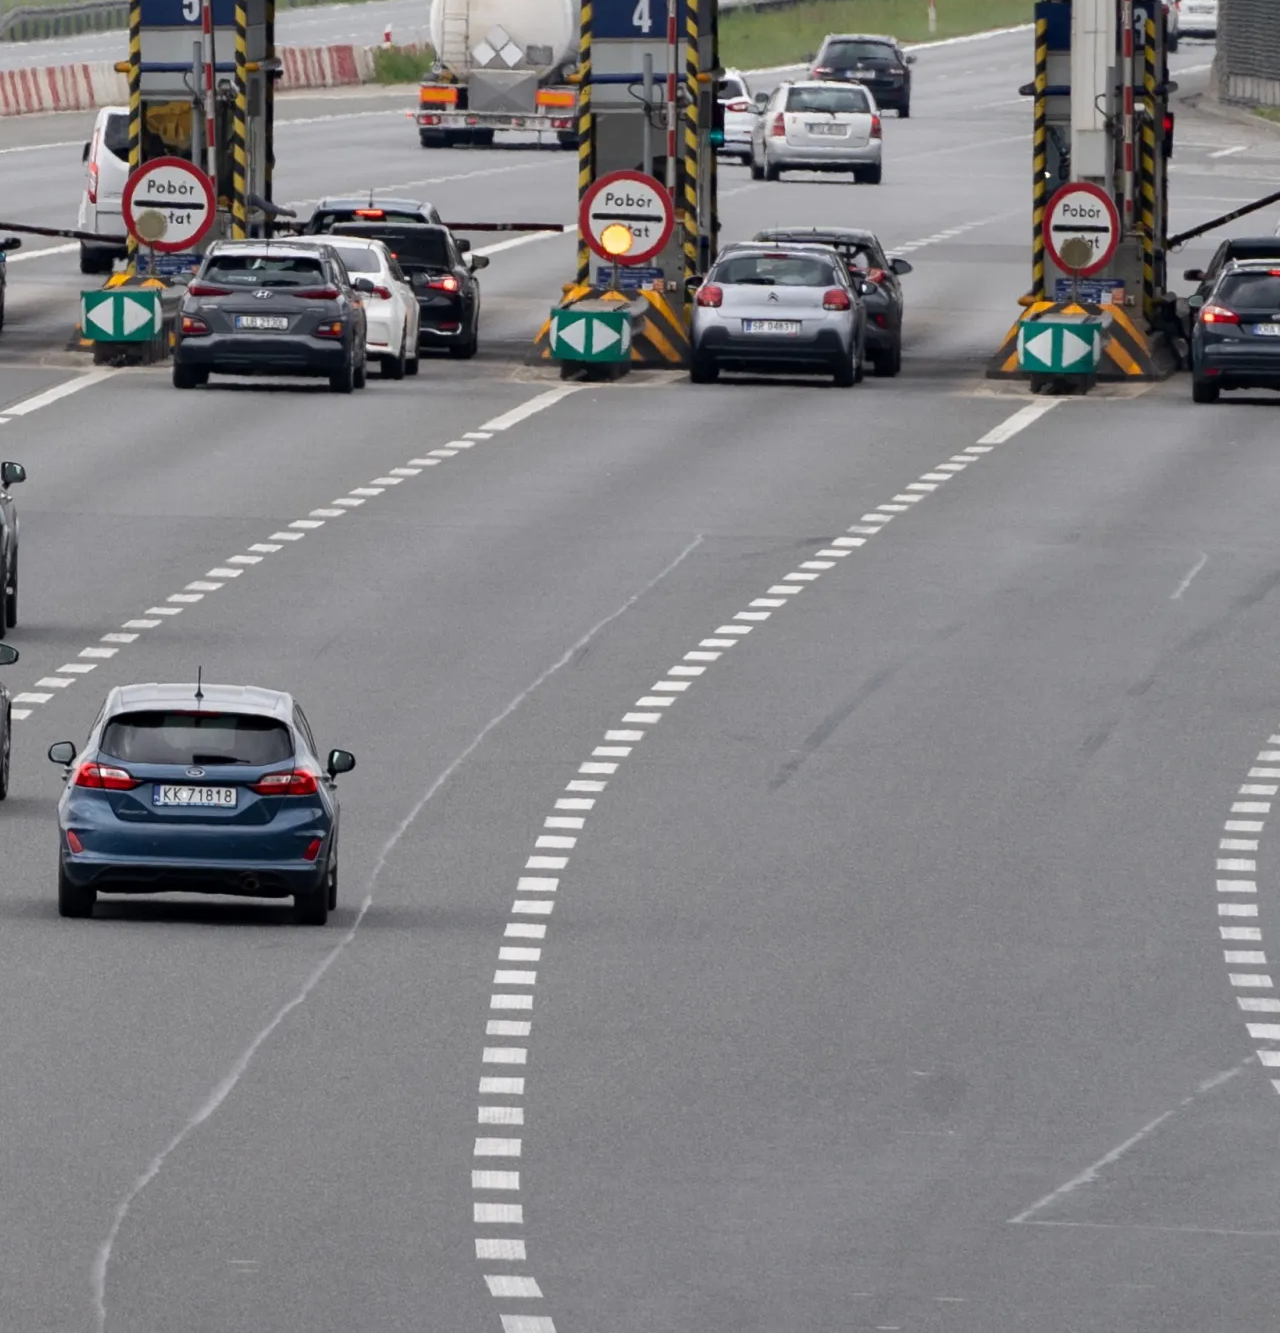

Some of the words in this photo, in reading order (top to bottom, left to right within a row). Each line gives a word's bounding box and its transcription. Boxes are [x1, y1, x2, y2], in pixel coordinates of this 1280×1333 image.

[147, 179, 195, 196] Pobór
[605, 192, 653, 208] Pobór
[167, 210, 192, 225] łat
[1062, 204, 1101, 218] Pobór
[163, 787, 182, 801] KK
[187, 787, 233, 803] 71818
